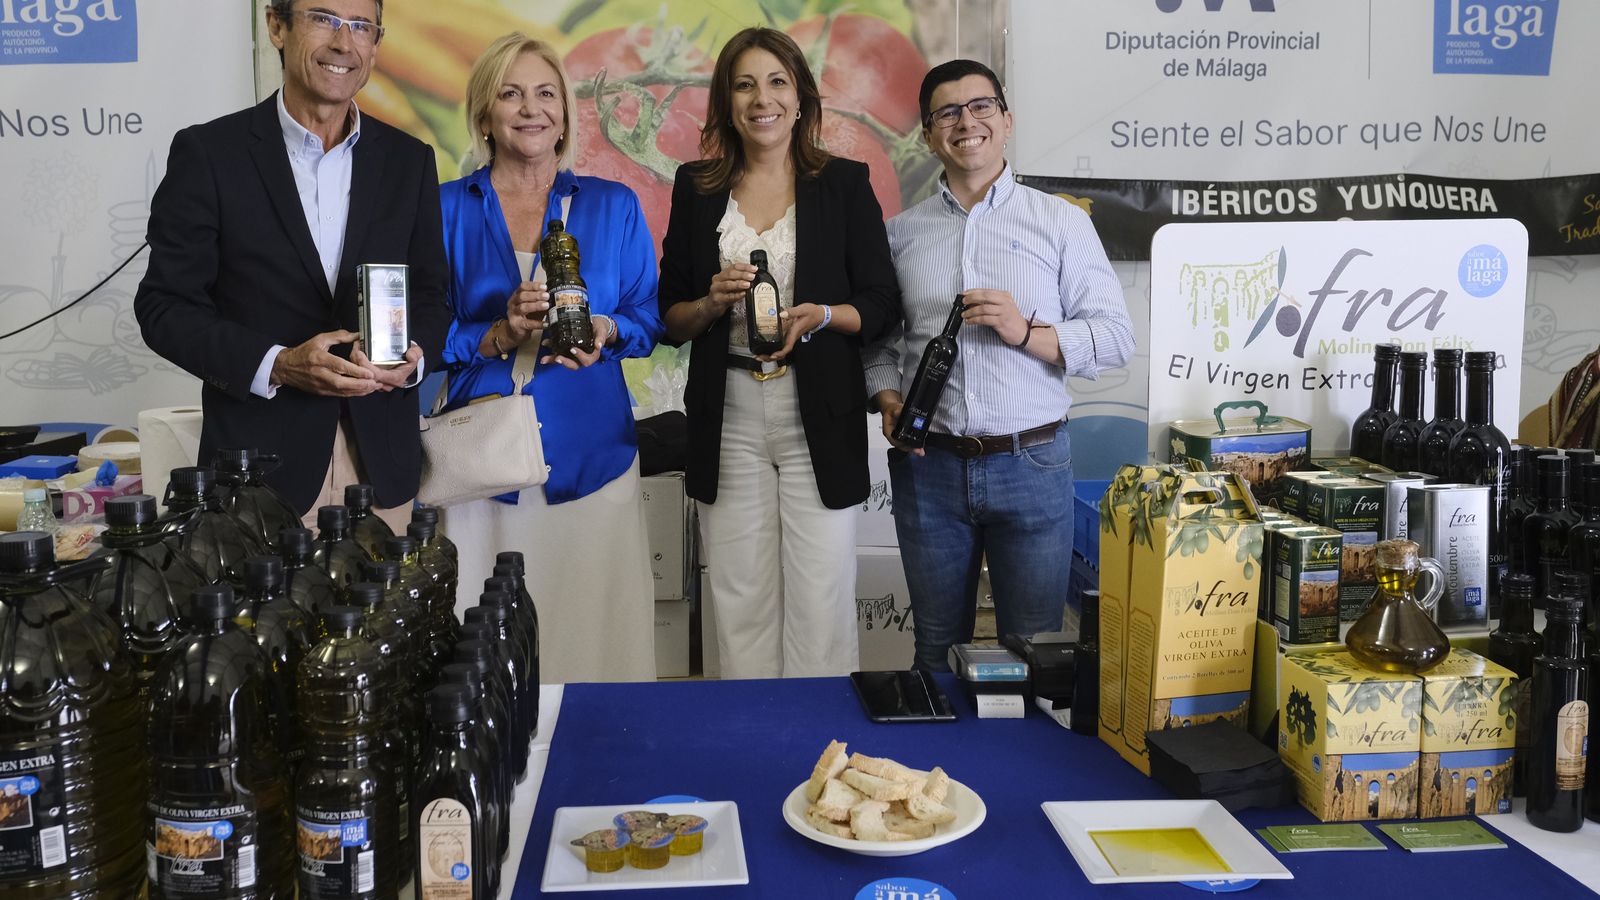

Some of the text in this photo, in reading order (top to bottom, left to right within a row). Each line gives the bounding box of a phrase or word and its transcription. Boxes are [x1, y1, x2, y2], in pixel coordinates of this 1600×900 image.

[1105, 30, 1320, 54] Diputación Provincial
[1163, 57, 1267, 82] de Málaga
[0, 107, 142, 137] Nos Une
[1110, 115, 1546, 150] Siente el Sabor que Nos Une
[1172, 182, 1498, 215] IBÉRICOS YUNQUERA
[1473, 252, 1502, 270] má
[1466, 265, 1501, 286] laga
[1293, 248, 1448, 358] fra
[1318, 337, 1376, 355] Molin
[1168, 354, 1194, 379] El
[1207, 361, 1289, 394] Virgen
[1353, 496, 1379, 515] fra
[1449, 507, 1476, 528] fra
[1317, 541, 1340, 559] fra
[1200, 580, 1248, 617] fra
[1178, 627, 1237, 639] ACEITE DE
[1164, 648, 1247, 662] VIRGEN EXTRA
[1190, 640, 1223, 649] OLIVA
[1368, 721, 1406, 747] fra
[1465, 719, 1502, 745] fra
[20, 754, 55, 769] EXTRA
[190, 808, 219, 818] VIRGEN
[220, 804, 245, 816] EXTRA
[313, 810, 340, 820] VIRGEN
[341, 809, 365, 820] EXTRA
[427, 800, 462, 823] fra
[875, 883, 908, 891] sabor
